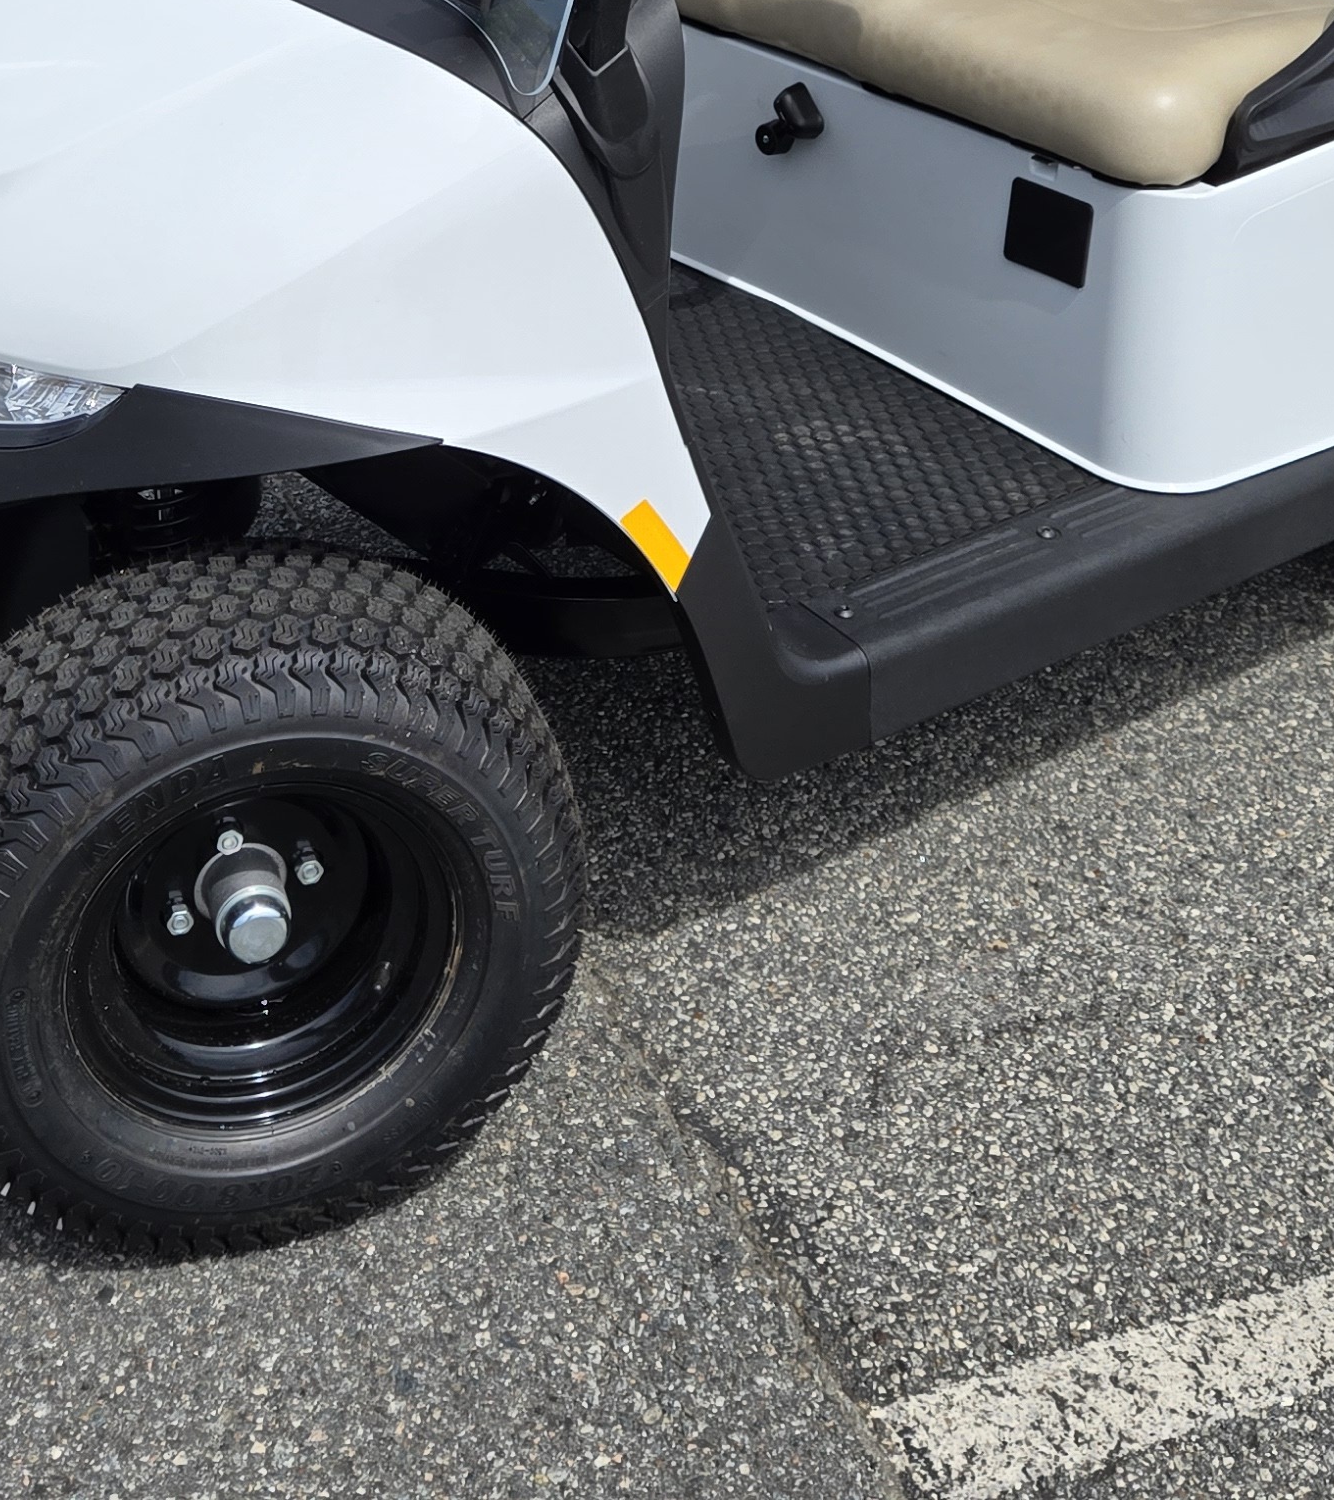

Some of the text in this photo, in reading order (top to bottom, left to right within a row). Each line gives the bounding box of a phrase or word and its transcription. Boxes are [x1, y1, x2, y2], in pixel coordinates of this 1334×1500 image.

[74, 754, 230, 874] KENDA
[361, 751, 522, 924] SUPER TURF
